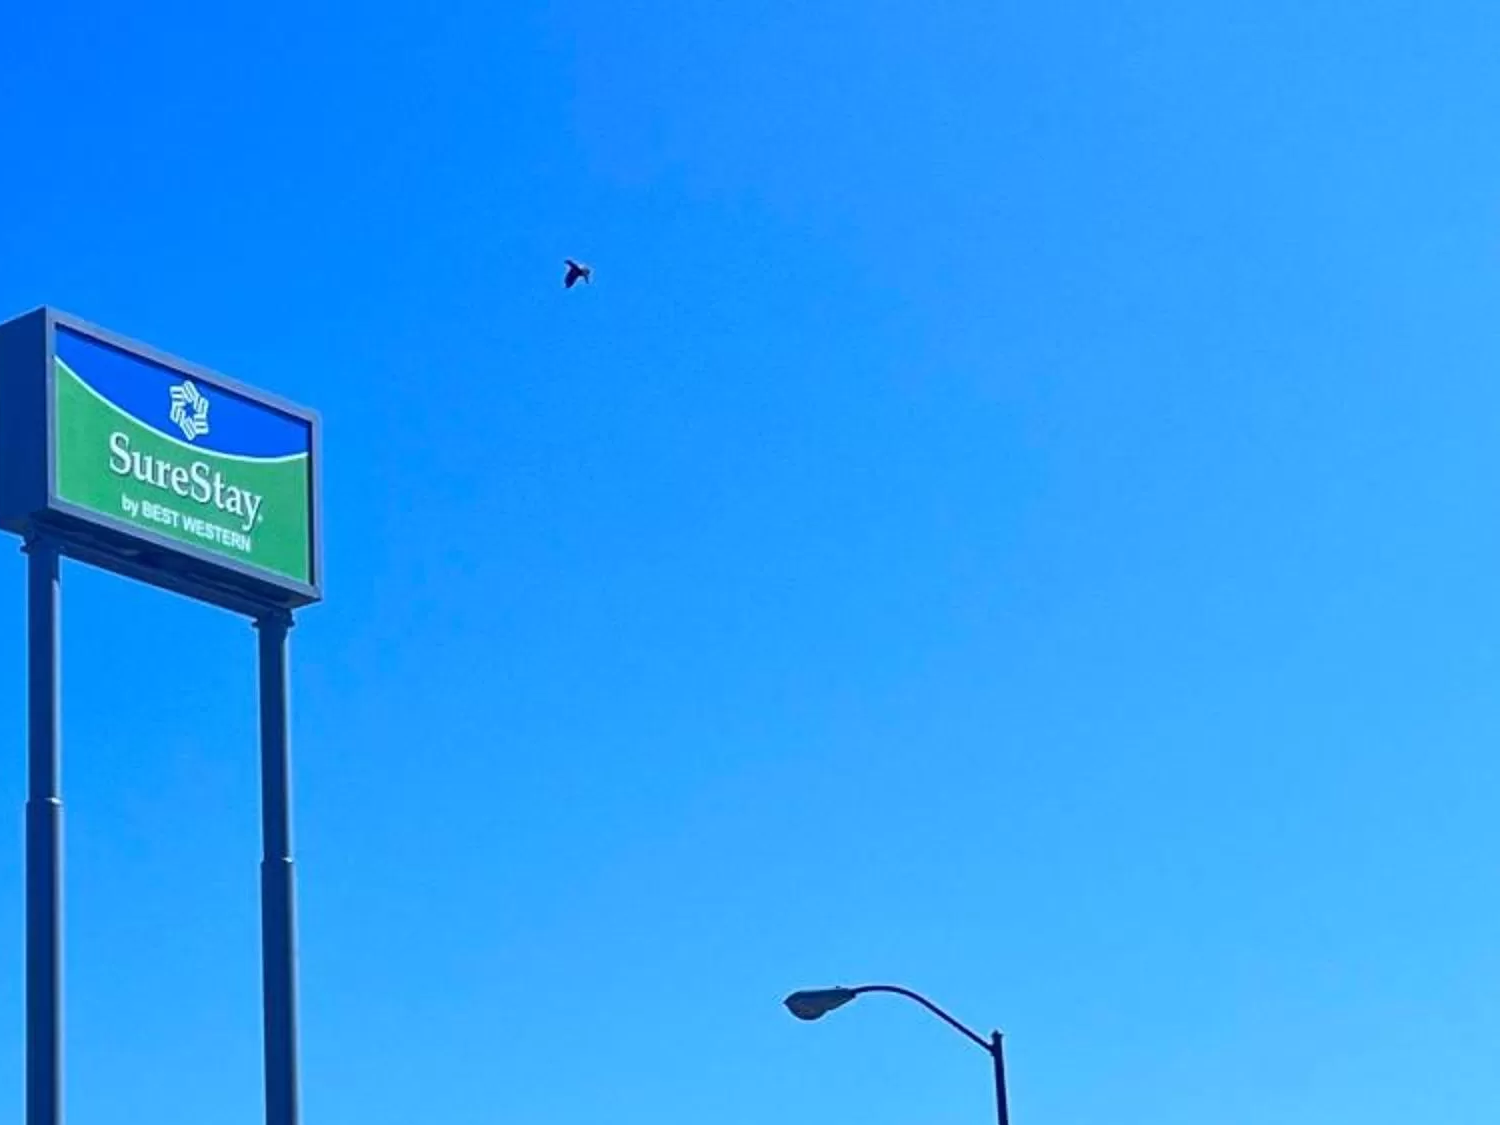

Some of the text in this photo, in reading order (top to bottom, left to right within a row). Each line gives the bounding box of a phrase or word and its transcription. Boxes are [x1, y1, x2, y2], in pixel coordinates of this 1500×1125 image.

[108, 431, 262, 531] SureStay
[121, 492, 252, 553] by BEST WESTERN
